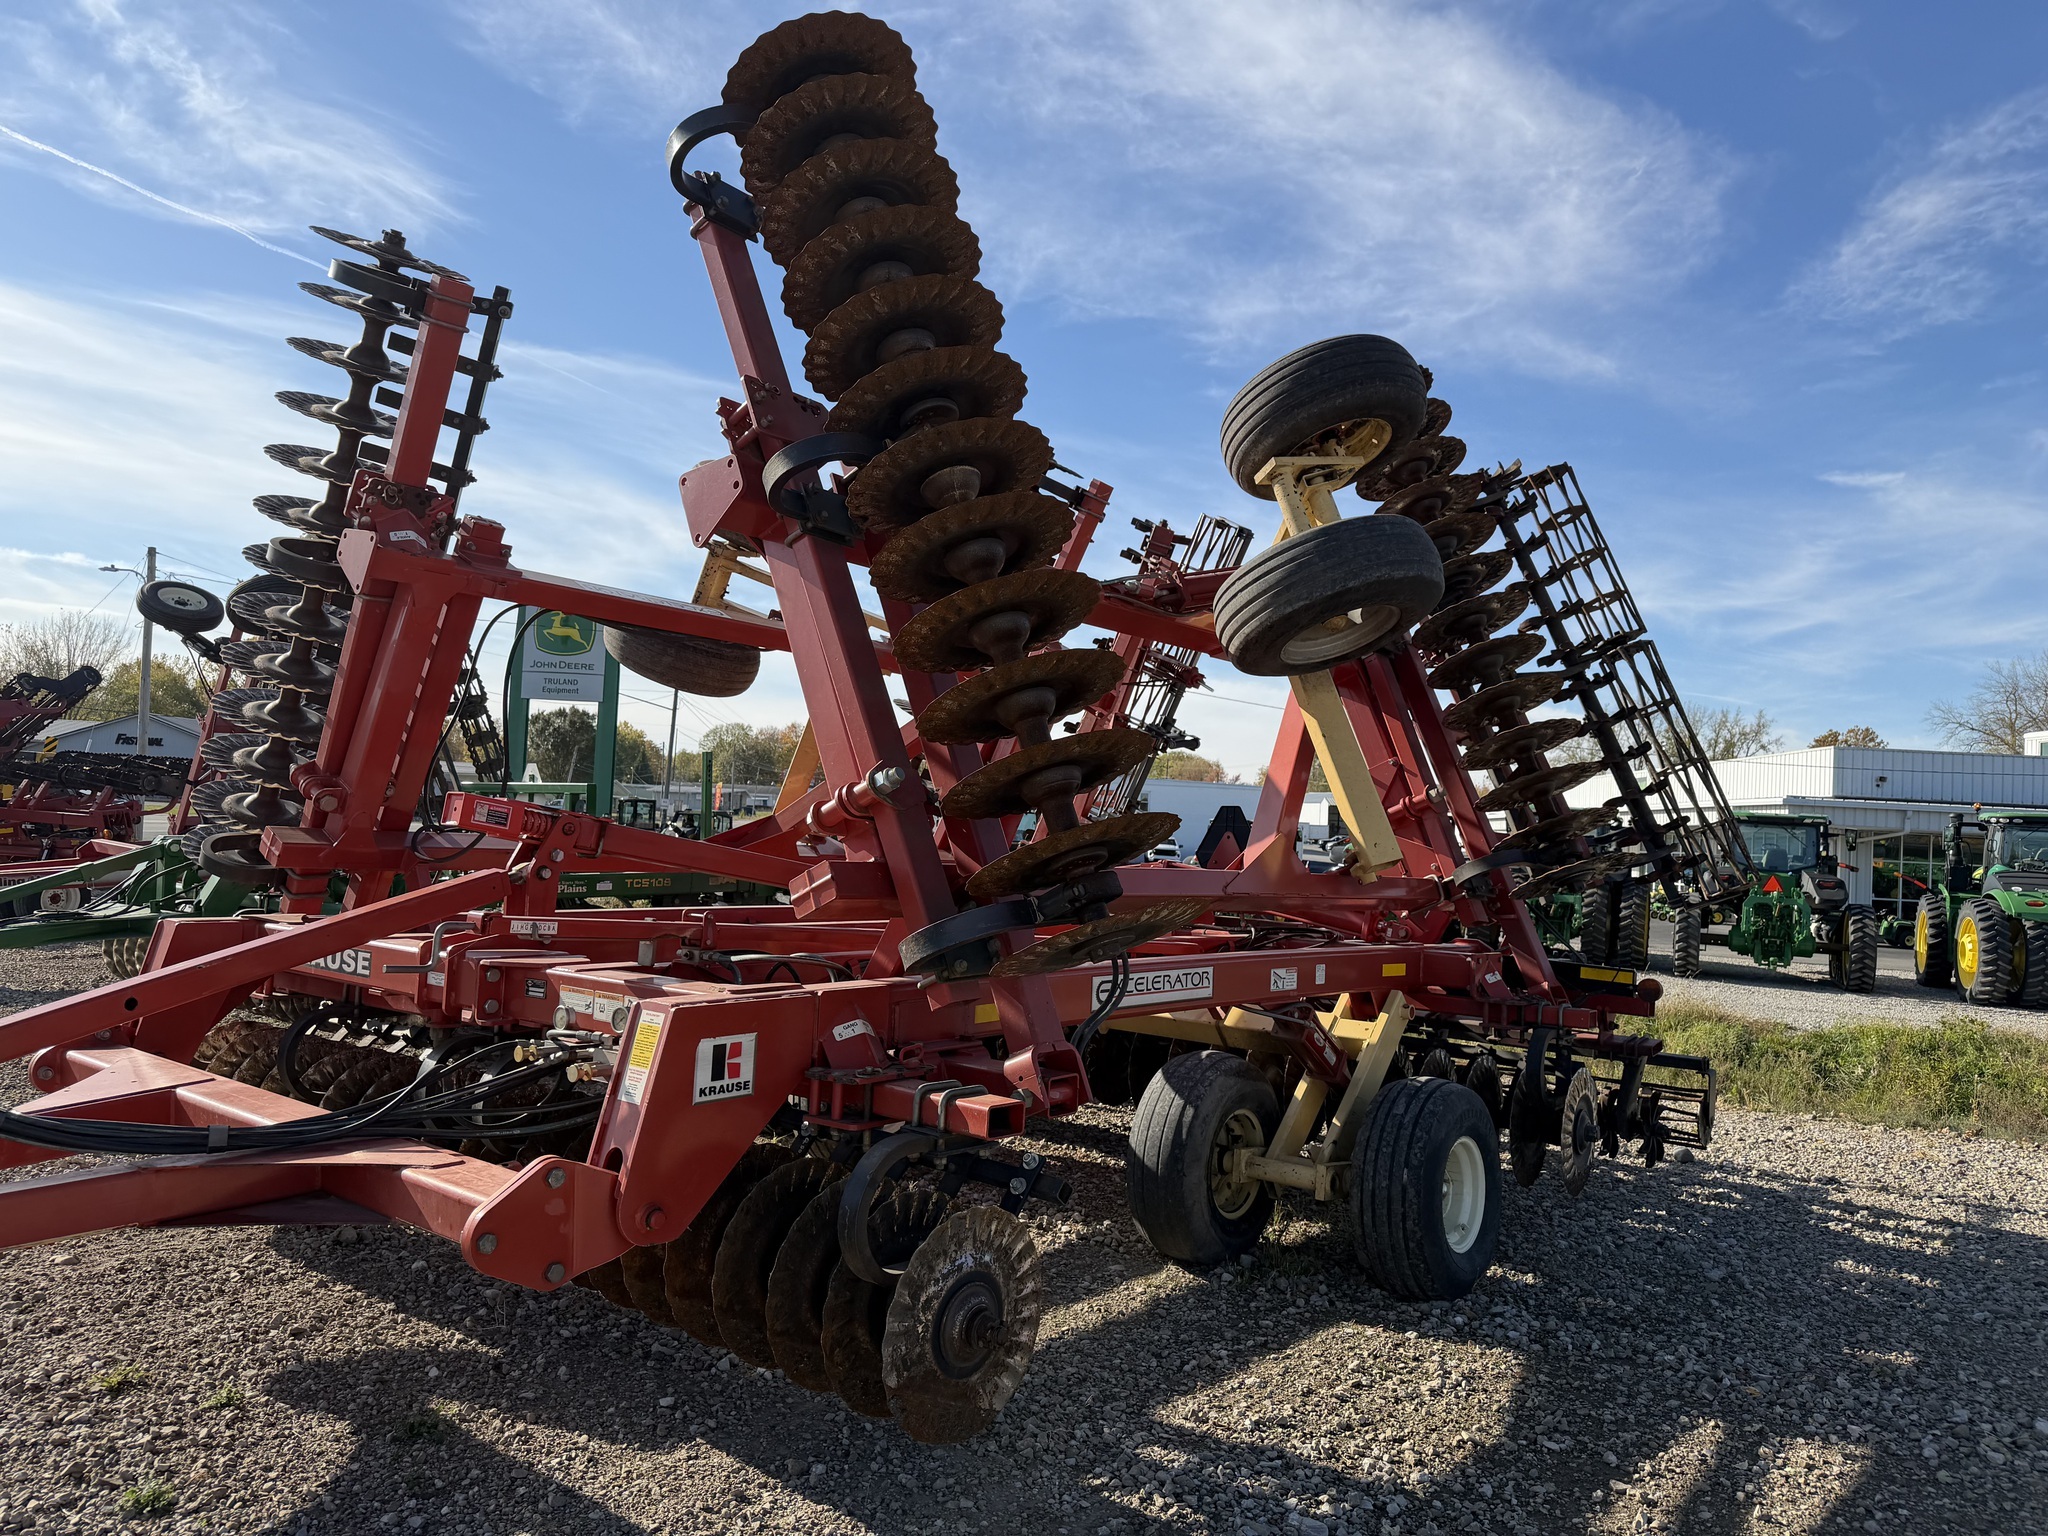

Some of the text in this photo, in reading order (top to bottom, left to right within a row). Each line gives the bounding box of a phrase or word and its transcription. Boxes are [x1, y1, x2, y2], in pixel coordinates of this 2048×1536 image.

[530, 660, 594, 670] JOHN DEERE
[542, 686, 579, 694] Equipment
[557, 884, 588, 893] Plains
[699, 1080, 751, 1097] KRAUSE
